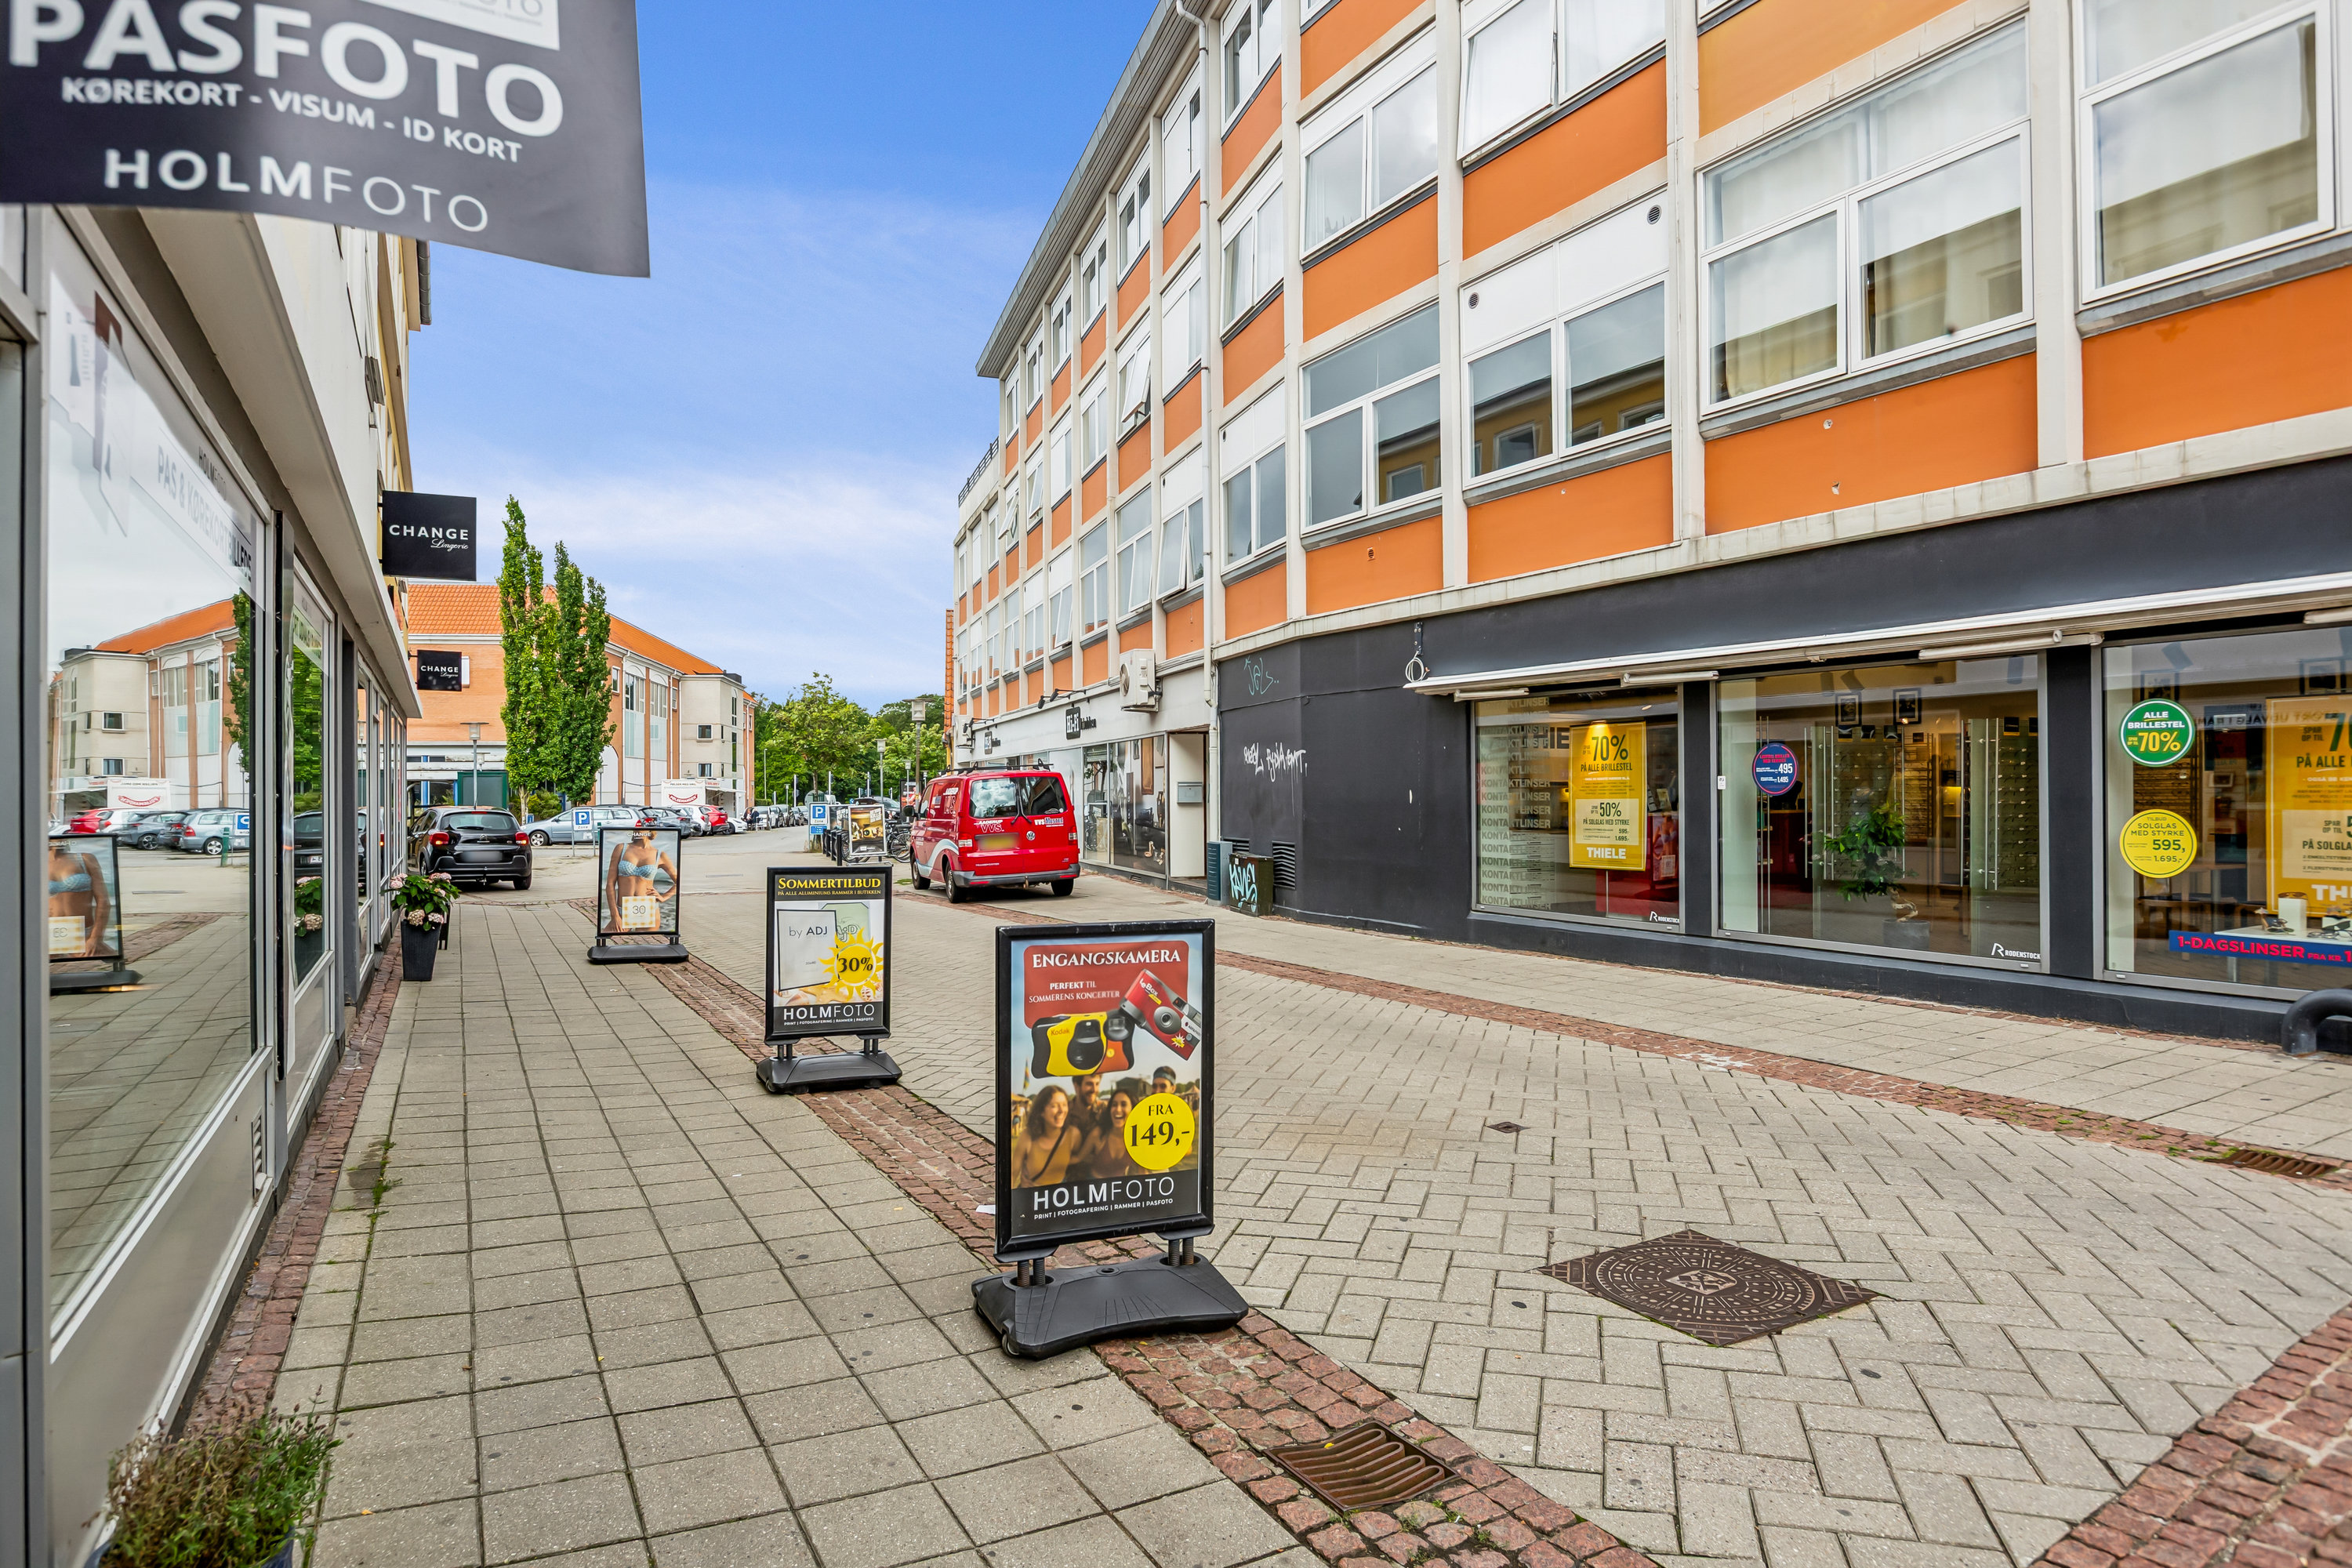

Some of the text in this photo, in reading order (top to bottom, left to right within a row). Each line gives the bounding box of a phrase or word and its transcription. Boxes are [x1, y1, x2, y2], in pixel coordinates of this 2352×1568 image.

[9, 0, 564, 138] PASFOTO
[62, 77, 243, 108] KØREKORT
[269, 90, 376, 131] VISUM
[403, 116, 436, 143] ID
[443, 128, 523, 163] KORT
[103, 148, 490, 233] HOLMFOTO
[389, 524, 469, 541] CHANGE
[430, 538, 469, 552] Lingerie
[420, 664, 459, 674] CHANGE
[2143, 710, 2169, 719] ALLE
[1066, 712, 1080, 734] Hi-Fi
[2127, 720, 2186, 729] BRILLESTEL
[2325, 713, 2352, 752] 7
[1592, 733, 1629, 762] 70%
[2138, 731, 2181, 752] 70%
[1580, 761, 1633, 772] PÅ ALLE BRILLESTEL
[2296, 753, 2346, 768] PÅ ALLE
[1778, 763, 1794, 774] 495
[815, 806, 824, 818] P
[1599, 802, 1622, 817] 50%
[578, 812, 588, 824] P
[2302, 839, 2352, 851] PÅ SOLGLA
[1586, 847, 1627, 859] THIELE
[778, 878, 881, 889] SOMMERTILBUD
[789, 926, 802, 939] by
[806, 926, 828, 936] ADJ
[2177, 935, 2305, 958] 1-DAGSLINSER
[1032, 949, 1181, 969] ENGANGSKAMERA
[2005, 949, 2041, 960] RODENSTOCK
[838, 956, 873, 973] 30%
[1049, 982, 1084, 991] PERFEKT
[1139, 978, 1159, 996] LeBox
[1028, 990, 1121, 1004] SOMMERENS KONCERTER
[783, 1004, 875, 1020] HOLMFOTO
[1051, 1026, 1071, 1036] Kodak
[1148, 1104, 1175, 1117] FRA
[1130, 1120, 1191, 1148] 149,-
[1033, 1176, 1175, 1211] HOLMFOTO
[1033, 1197, 1174, 1221] PRINT FOTOGRAFERING RAMMER PASFOTO
